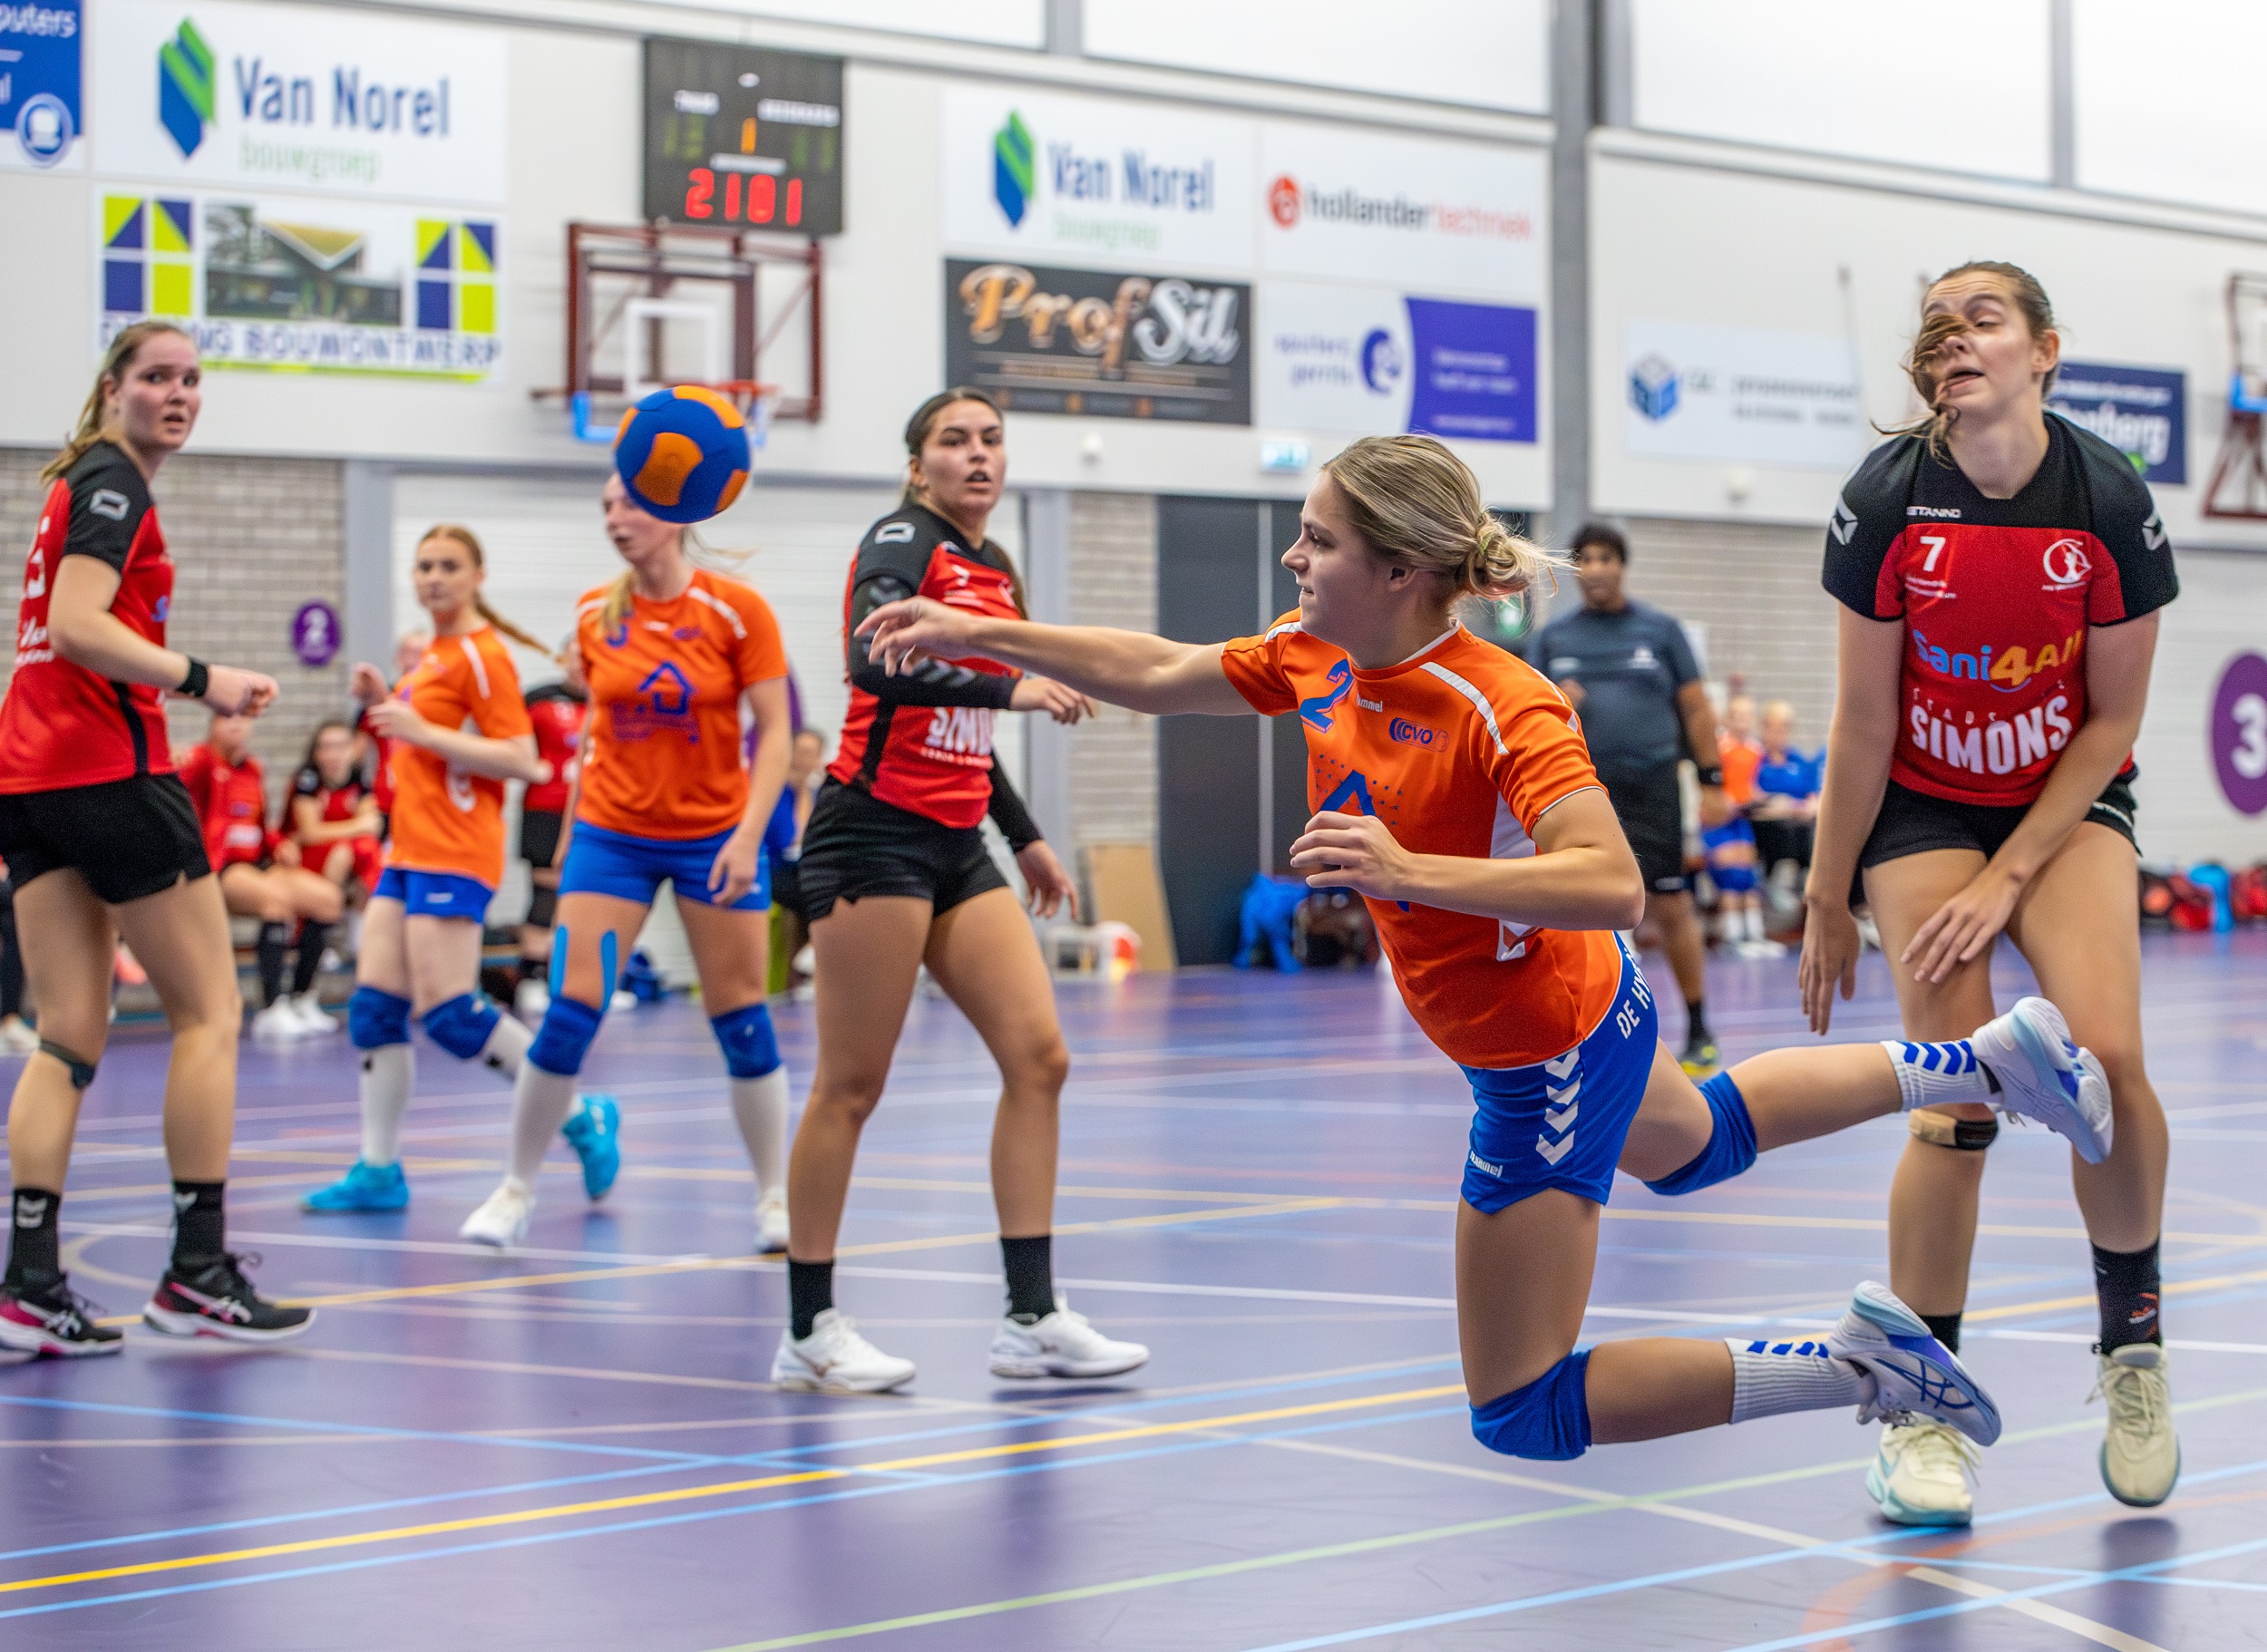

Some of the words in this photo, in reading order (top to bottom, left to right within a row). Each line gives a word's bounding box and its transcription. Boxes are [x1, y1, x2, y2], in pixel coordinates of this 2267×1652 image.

[233, 55, 315, 124] Van
[331, 64, 451, 140] Norel
[1047, 140, 1112, 201] Van
[1121, 147, 1216, 214] Norel
[1920, 536, 1947, 572] 7
[1299, 658, 1355, 734] 2
[1911, 695, 2073, 776] SIMONS
[2230, 692, 2267, 781] 3
[1616, 999, 1640, 1039] DE
